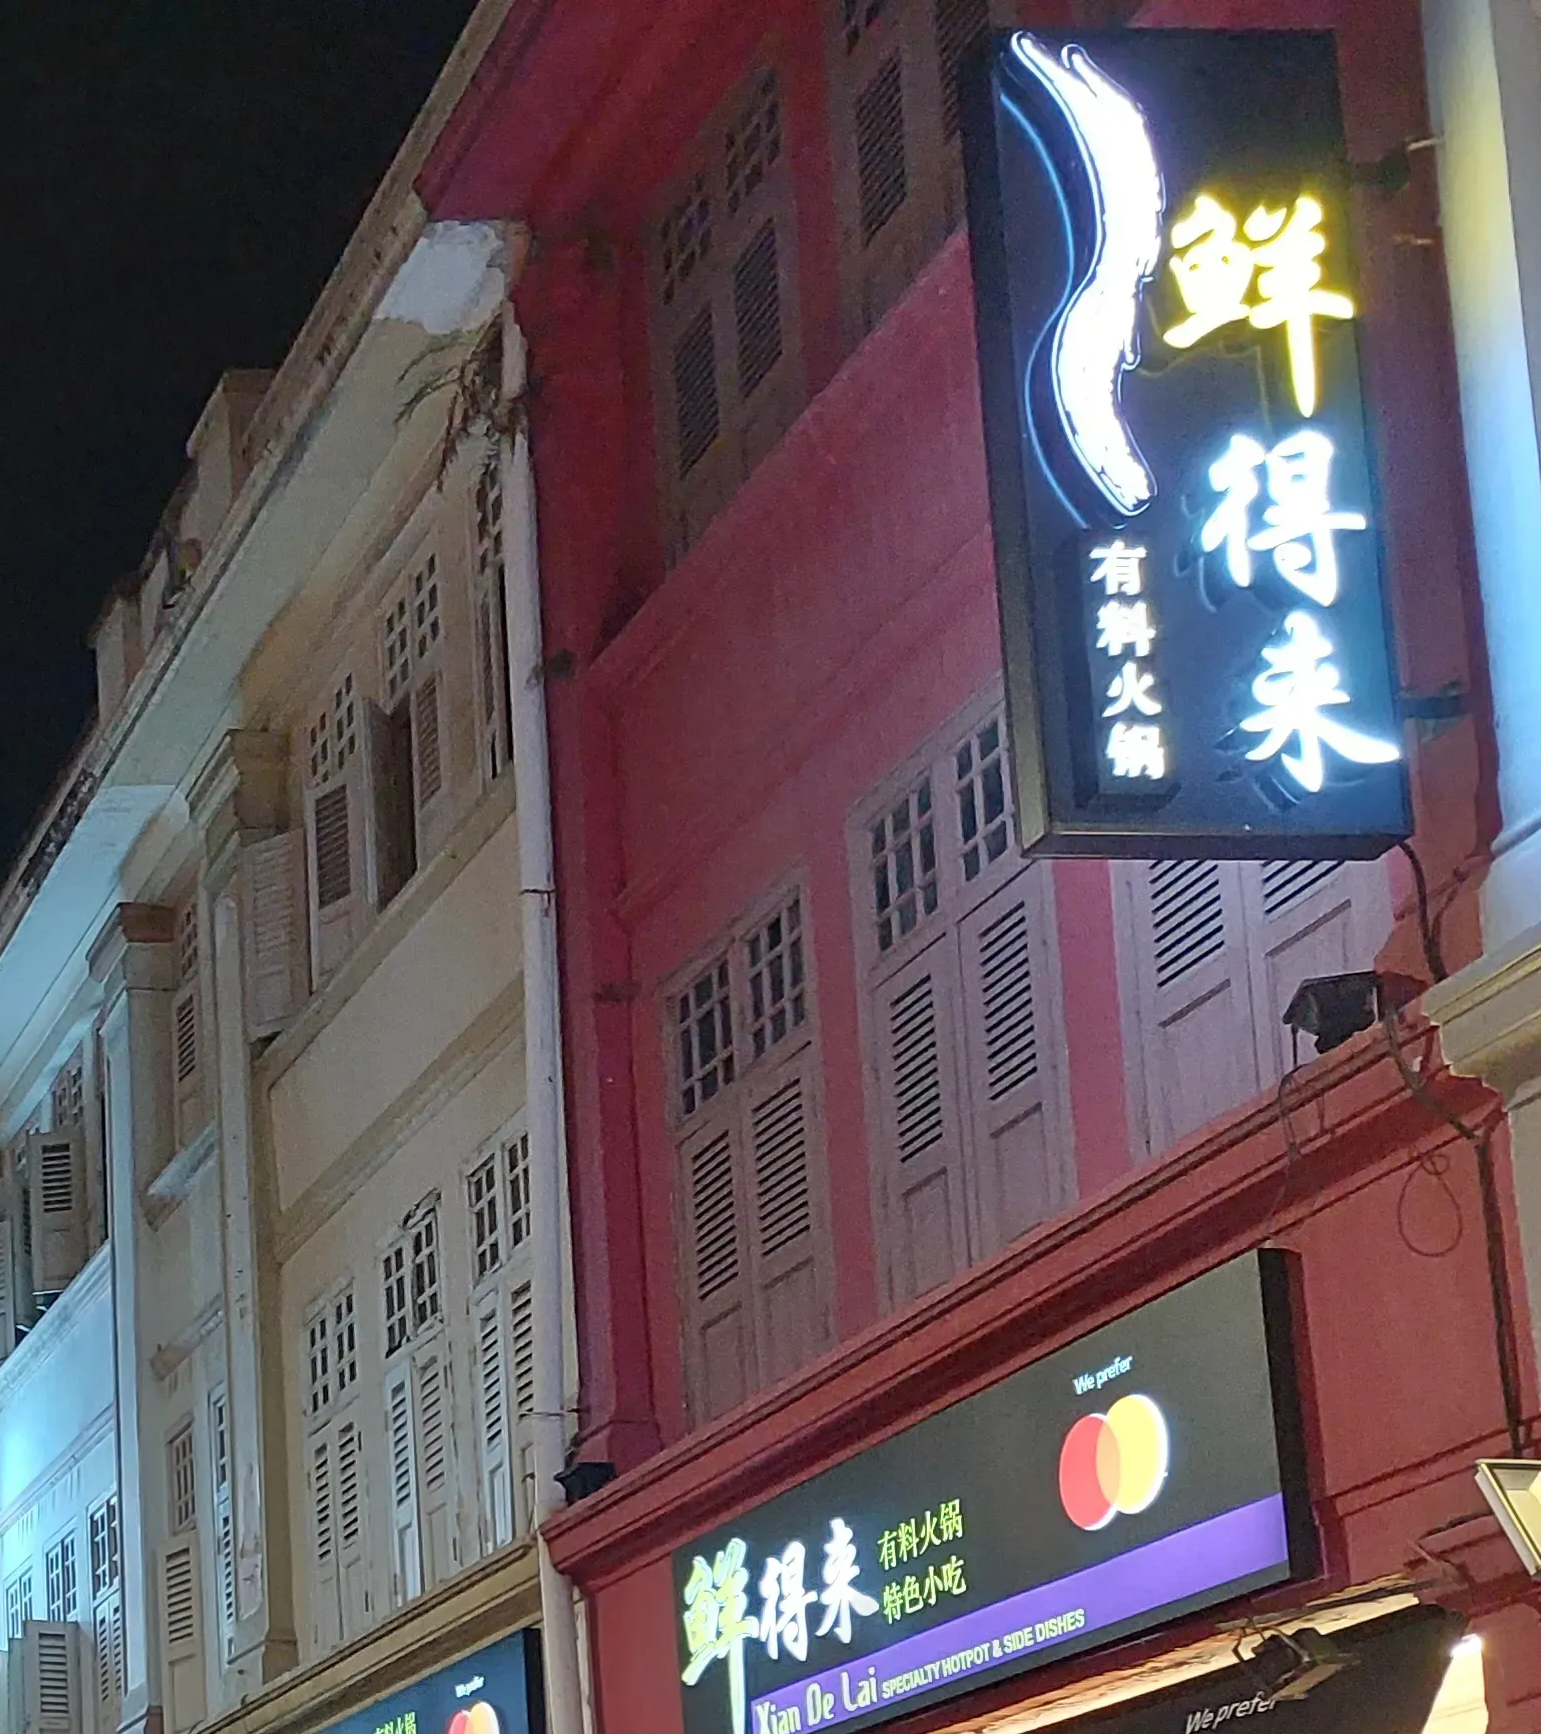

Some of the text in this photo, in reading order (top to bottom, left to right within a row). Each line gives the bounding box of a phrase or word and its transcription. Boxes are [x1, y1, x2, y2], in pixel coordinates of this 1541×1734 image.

[1163, 193, 1403, 794] 鲜得来
[1089, 540, 1167, 781] 有料火锅
[1073, 1354, 1134, 1395] We prefer
[877, 1498, 964, 1571] 有料火锅
[882, 1554, 968, 1625] 特色小吃
[806, 1683, 835, 1727] De
[842, 1666, 878, 1713] Lai
[881, 1666, 942, 1700] SPECIALTY
[941, 1641, 991, 1683] HOTPOT
[992, 1642, 1003, 1660] &
[1003, 1626, 1034, 1654] SIDE
[1036, 1608, 1085, 1642] DISHES
